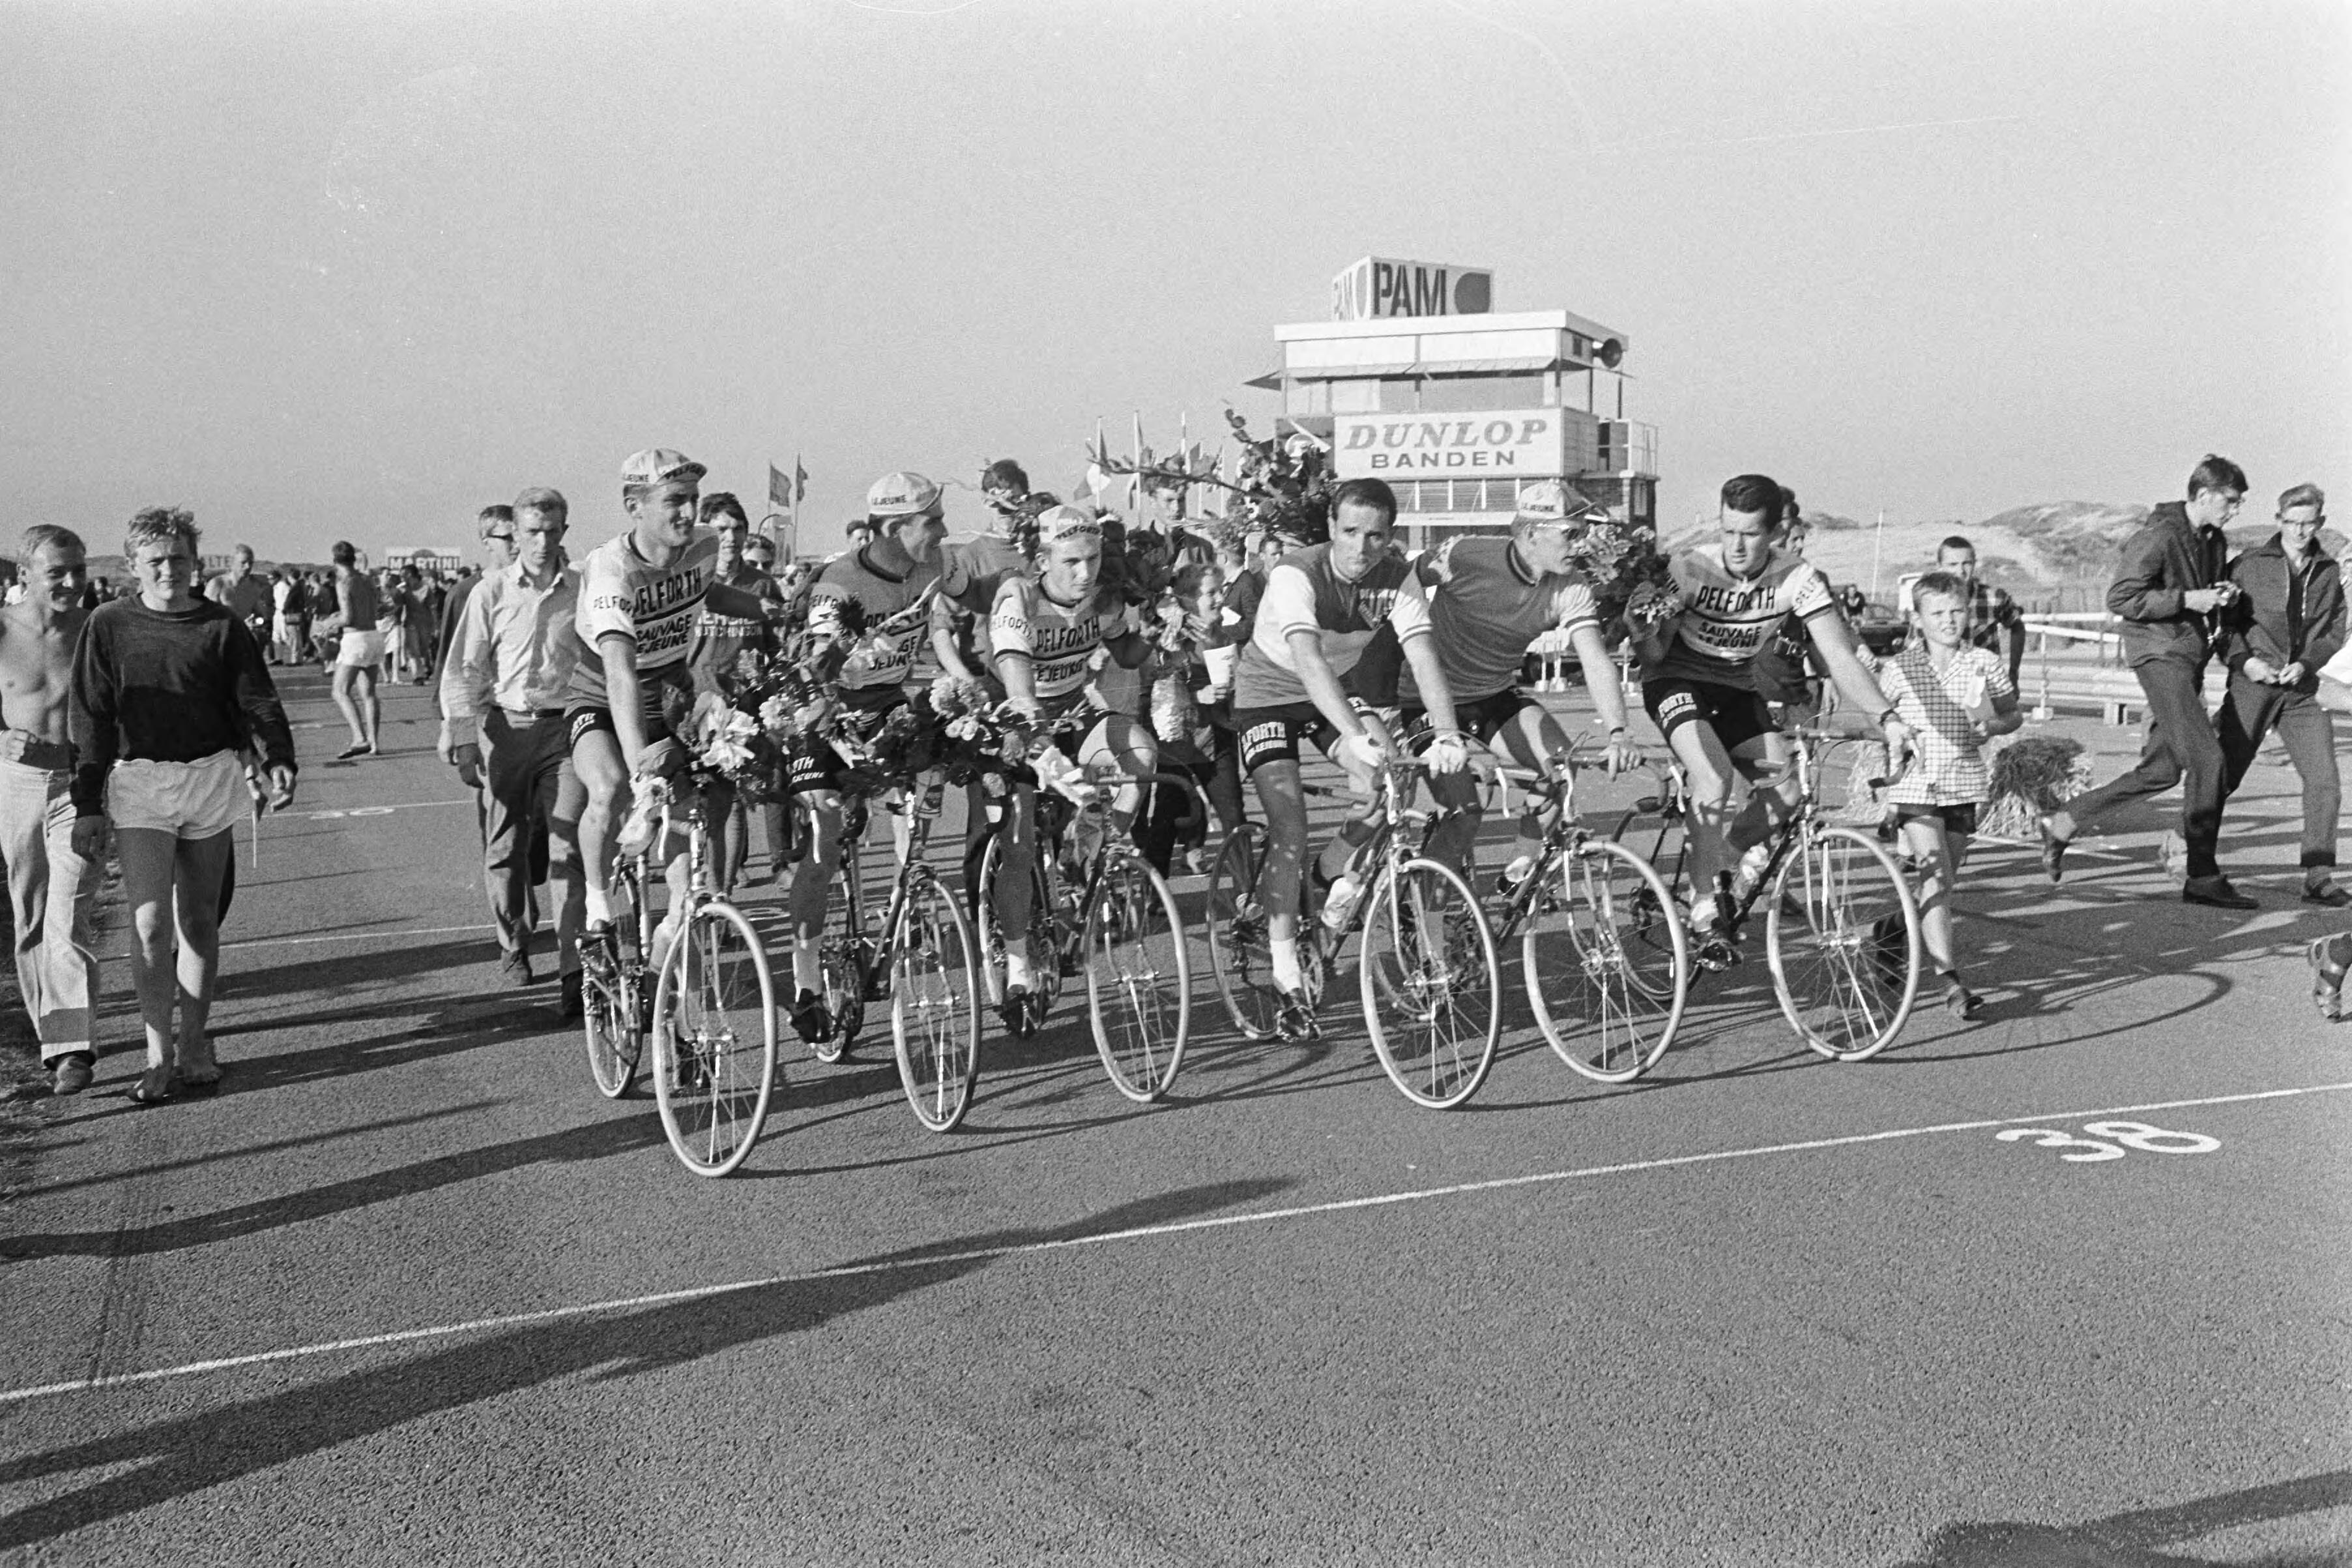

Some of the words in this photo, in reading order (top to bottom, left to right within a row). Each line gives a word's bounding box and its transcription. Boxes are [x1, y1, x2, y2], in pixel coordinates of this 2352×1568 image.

[1373, 262, 1446, 317] PAM
[1343, 419, 1548, 450] DUNLOP
[1371, 450, 1515, 469] BANDEN
[1696, 585, 1776, 613] PELFORTH
[1035, 615, 1101, 652] PELFORTH
[1698, 621, 1762, 638] SAUVAGE
[1996, 1121, 2222, 1162] 38
